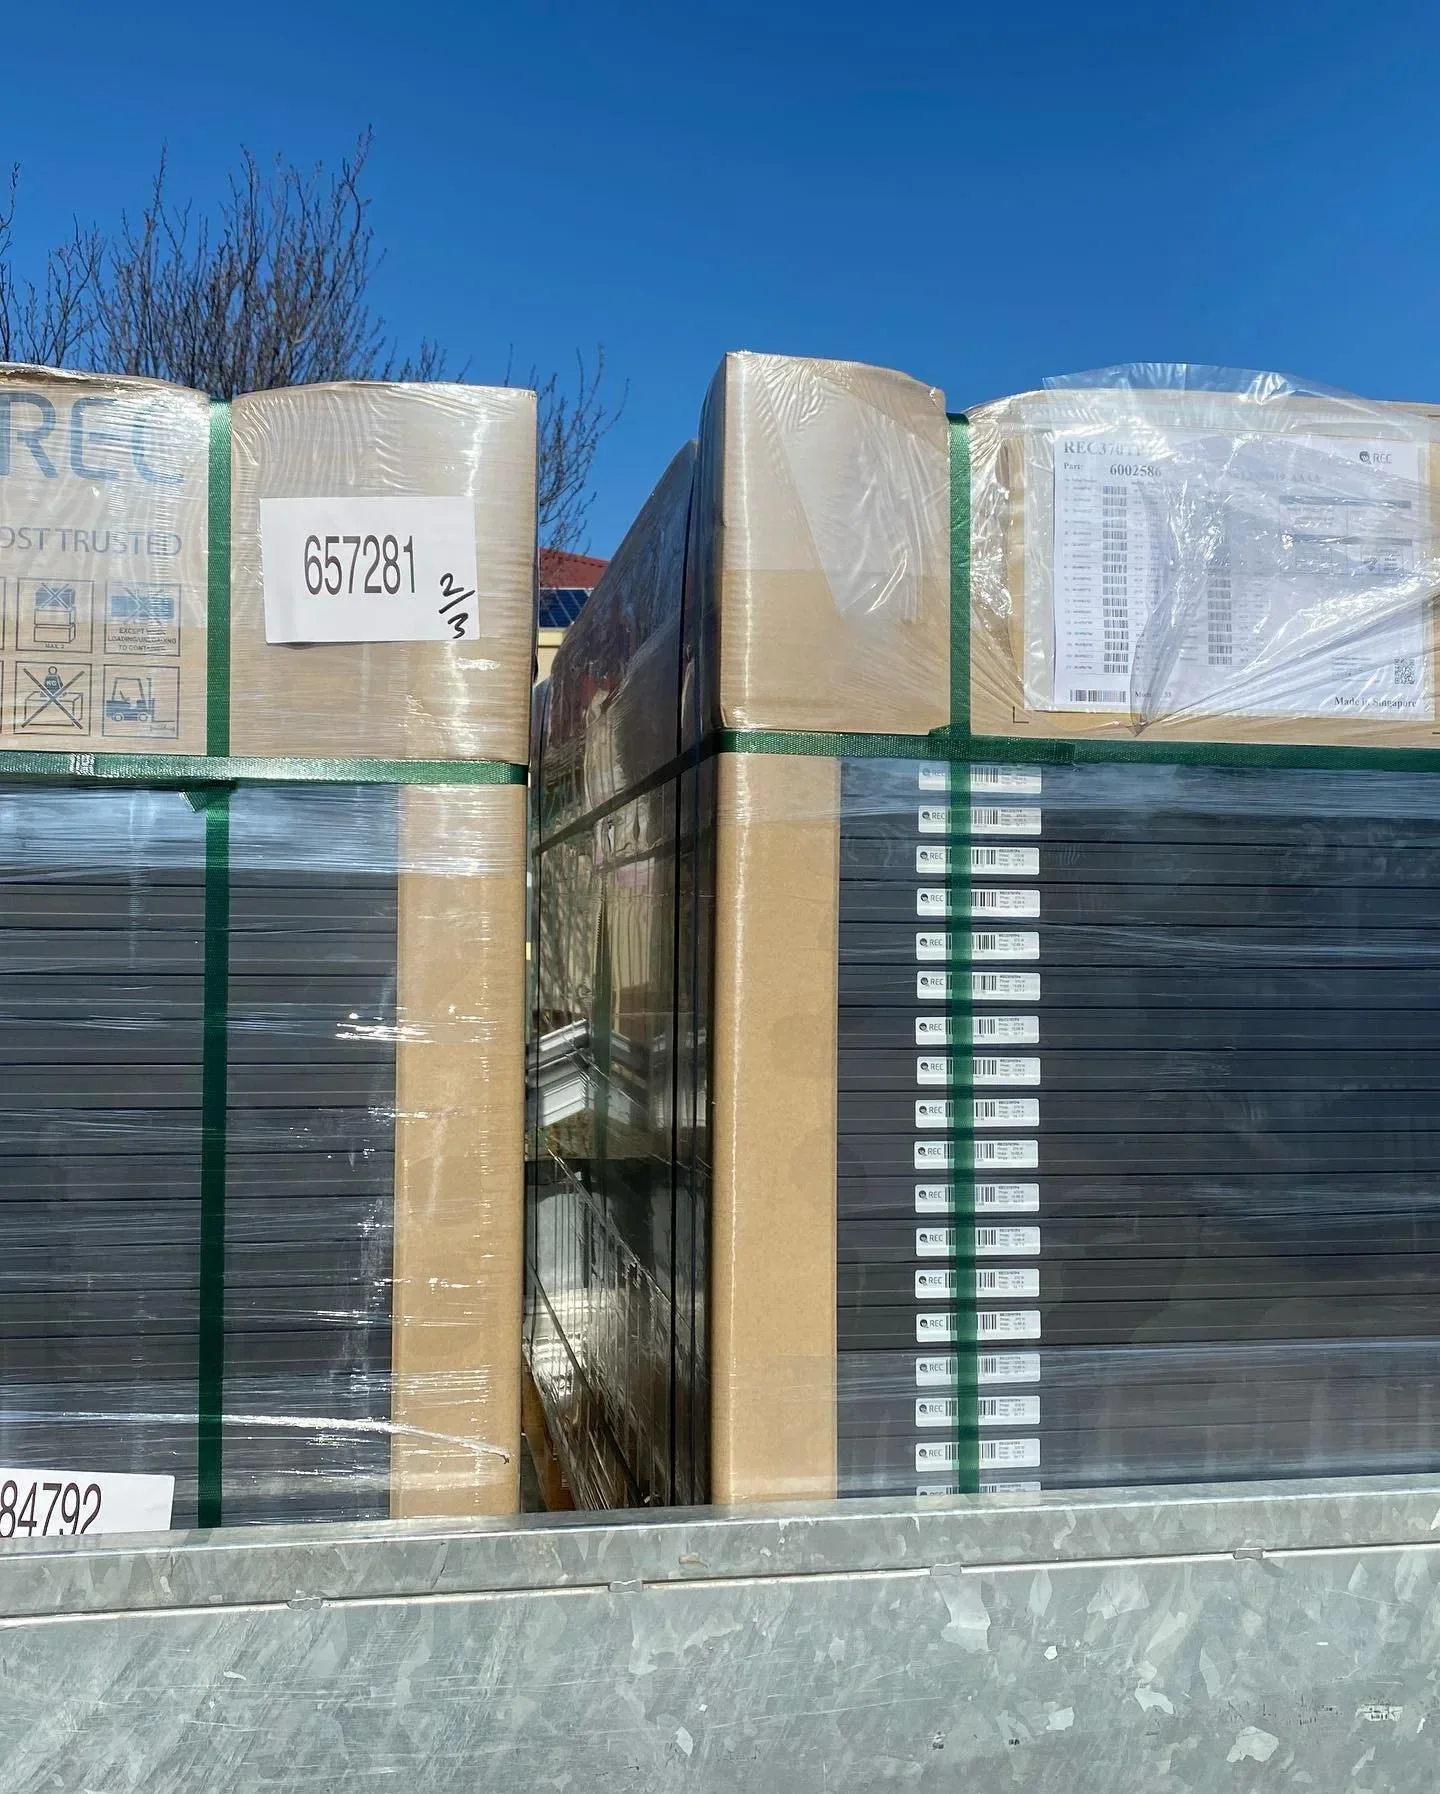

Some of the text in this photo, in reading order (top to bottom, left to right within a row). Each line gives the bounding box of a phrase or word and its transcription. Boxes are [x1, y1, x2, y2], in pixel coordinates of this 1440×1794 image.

[0, 392, 185, 484] REC
[1109, 463, 1162, 478] 6002586
[55, 528, 182, 556] TRUSTED
[304, 534, 415, 595] 657281
[1334, 696, 1359, 706] Made
[931, 812, 945, 820] REC
[929, 852, 943, 860] REC
[930, 894, 944, 902] REC
[929, 938, 943, 946] REC
[930, 978, 944, 986] REC
[929, 1023, 943, 1031] REC
[930, 1063, 944, 1071] REC
[929, 1106, 943, 1114] REC
[928, 1147, 942, 1155] REC
[929, 1191, 942, 1199] REC
[930, 1234, 943, 1242] REC
[929, 1277, 942, 1285] REC
[929, 1319, 943, 1327] REC
[929, 1363, 943, 1371] REC
[928, 1404, 943, 1413] REC
[928, 1449, 943, 1457] REC
[0, 1480, 102, 1537] 84792
